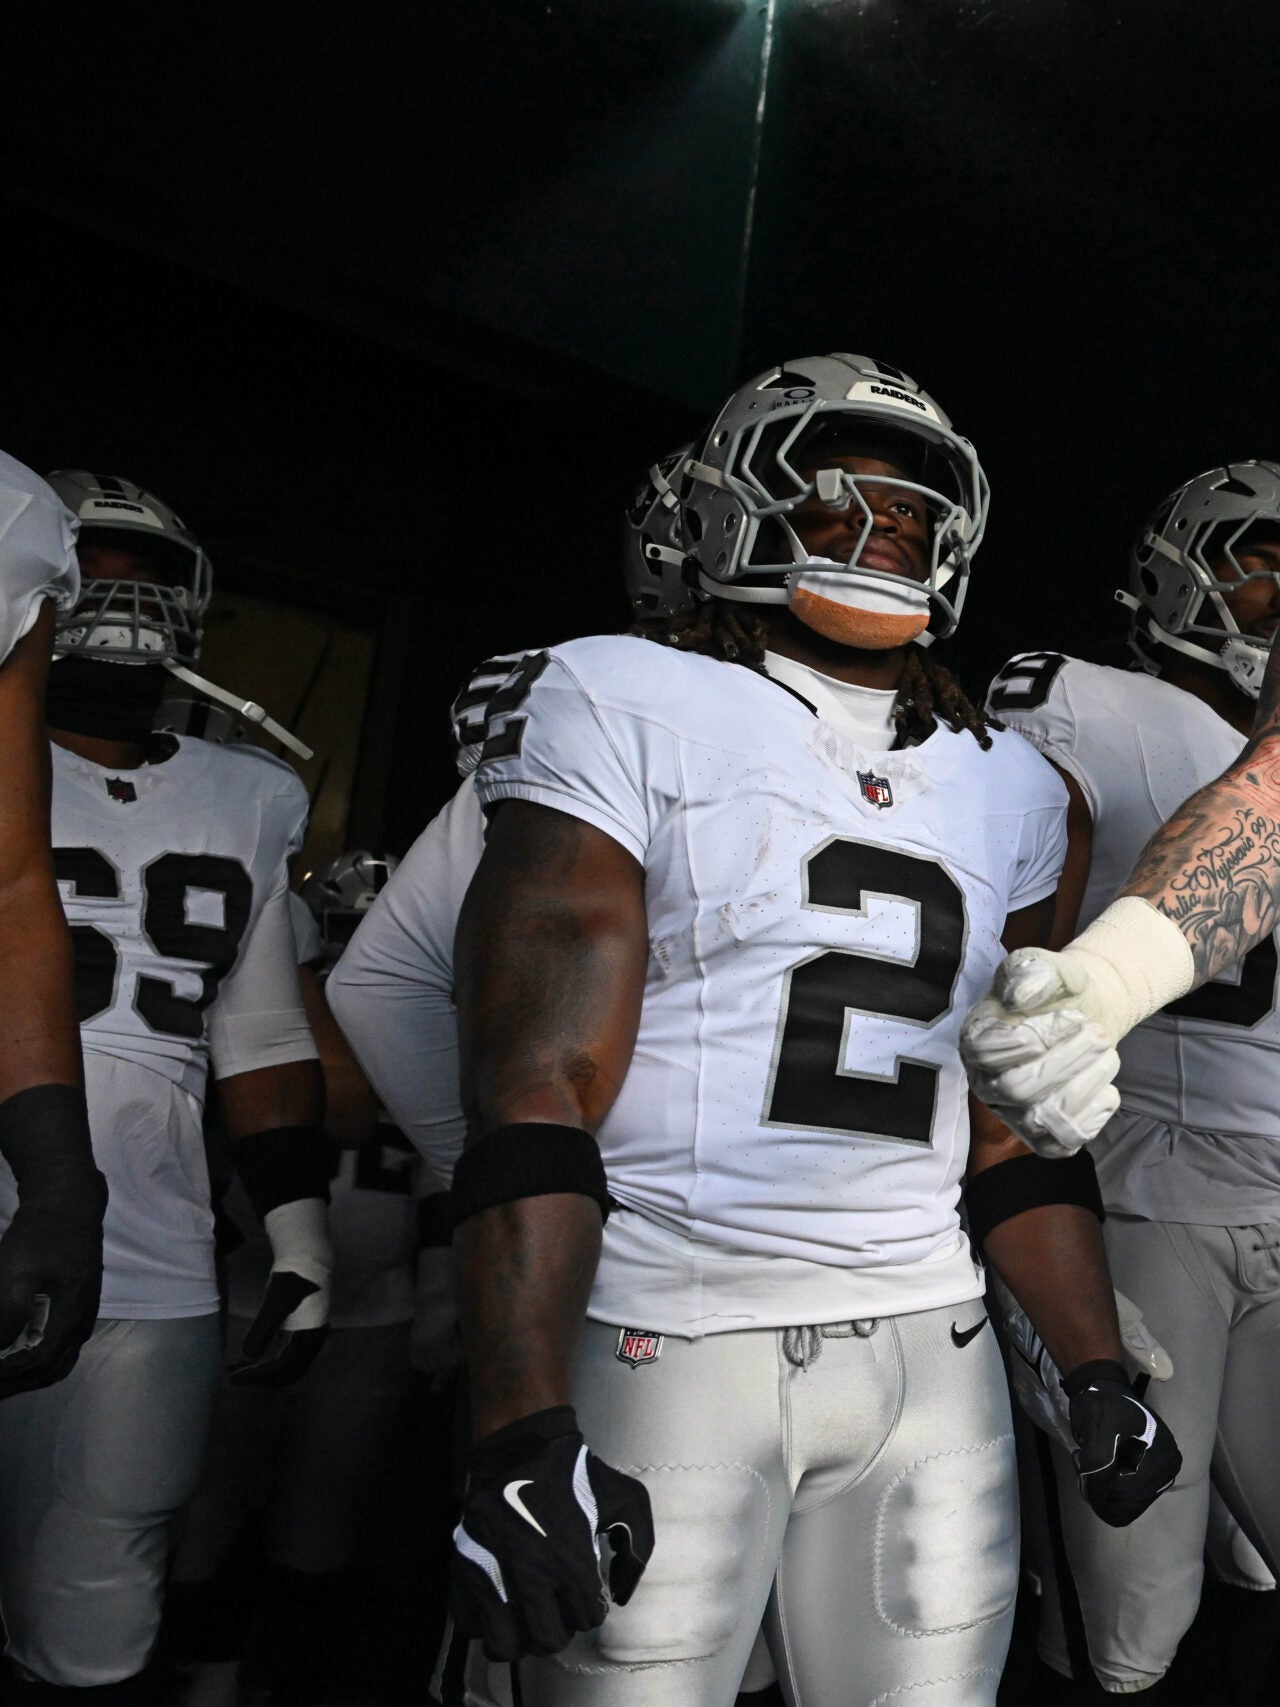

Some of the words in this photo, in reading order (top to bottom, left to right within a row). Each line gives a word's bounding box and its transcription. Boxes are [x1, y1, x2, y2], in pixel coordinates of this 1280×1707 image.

[870, 385, 927, 412] RAIDERS
[988, 651, 1069, 712] 9
[865, 784, 890, 803] NFL
[762, 833, 971, 1148] 2
[623, 1336, 653, 1358] NFL
